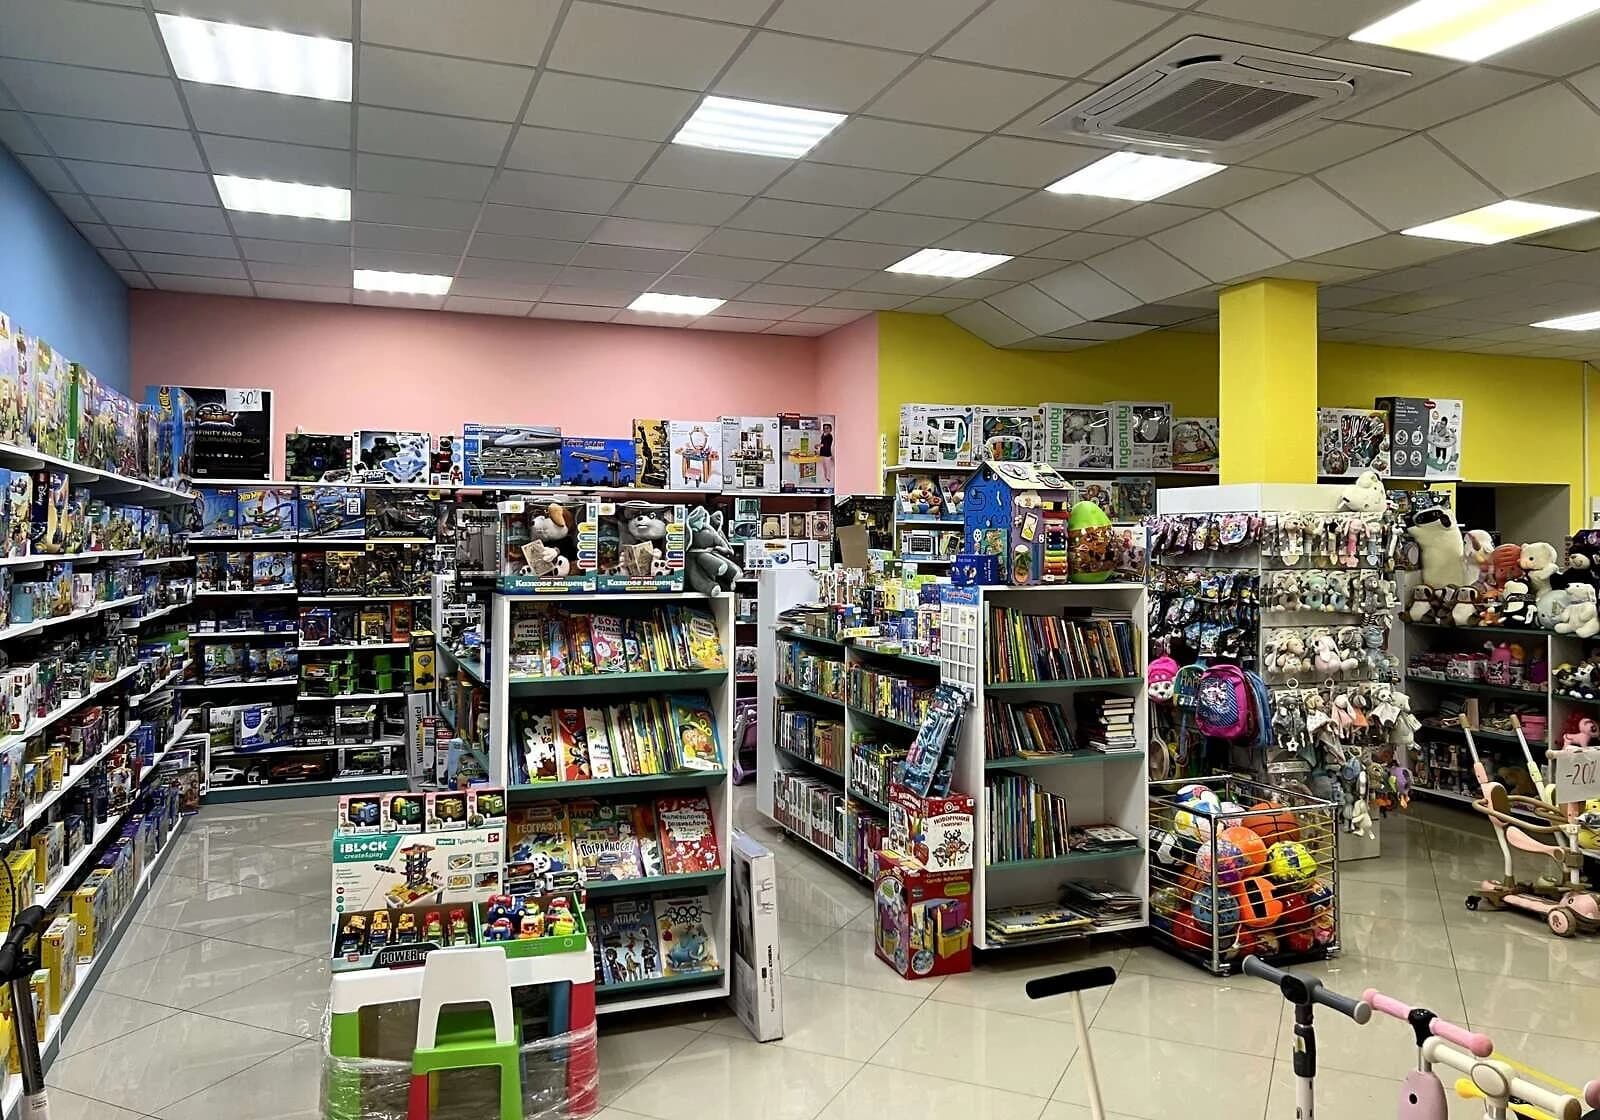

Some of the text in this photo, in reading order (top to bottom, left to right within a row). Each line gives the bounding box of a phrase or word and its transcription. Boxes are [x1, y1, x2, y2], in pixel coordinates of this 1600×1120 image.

[1048, 407, 1063, 463] ingenuity
[1116, 405, 1132, 468] ingenuity
[1566, 760, 1598, 785] -20%
[381, 949, 418, 965] POWER
